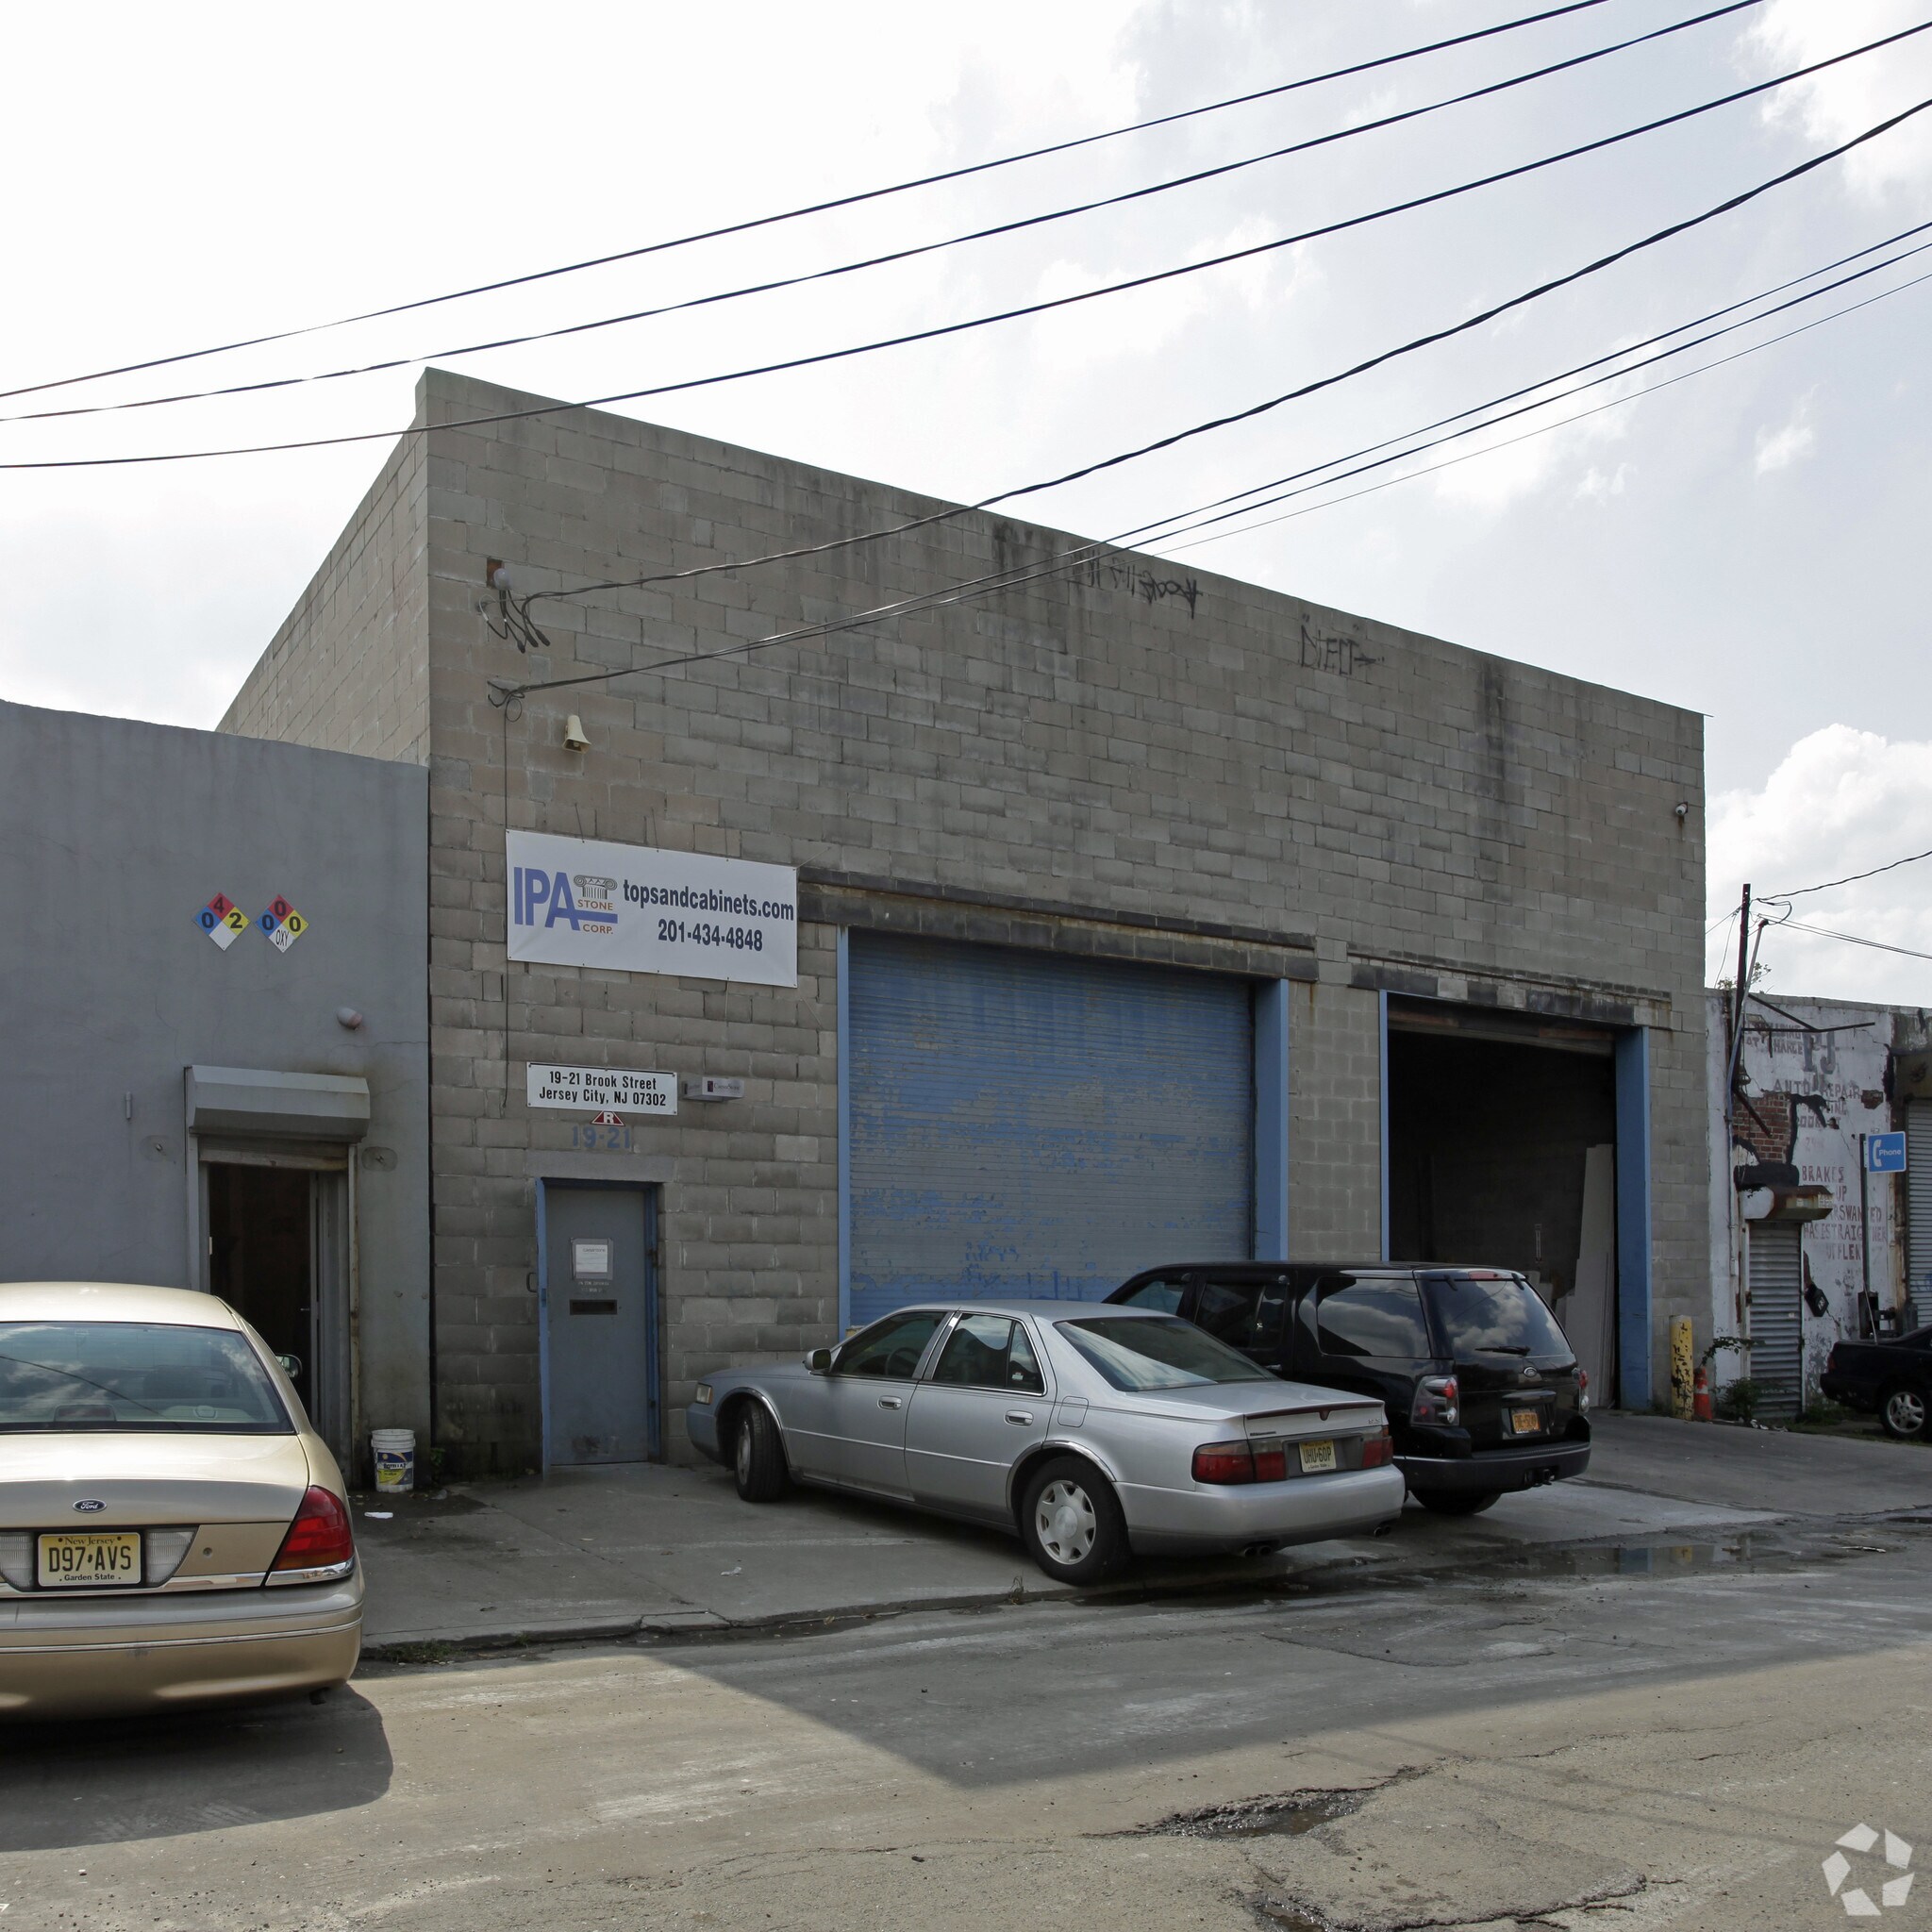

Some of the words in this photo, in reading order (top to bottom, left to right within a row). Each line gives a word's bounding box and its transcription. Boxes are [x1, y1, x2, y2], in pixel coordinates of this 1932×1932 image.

[213, 896, 225, 913] 4
[513, 866, 602, 932] IPA
[577, 898, 613, 911] STONE
[623, 878, 794, 921] topsandcabinets.com
[274, 900, 287, 916] 0
[201, 911, 214, 929] 0
[228, 912, 243, 929] 2
[261, 914, 275, 931] 0
[289, 916, 301, 932] 0
[275, 928, 290, 947] OXY
[582, 923, 614, 935] CORP.
[658, 918, 763, 952] 201-434-4848
[549, 1071, 580, 1085] 19-21
[585, 1073, 617, 1088] Brook
[622, 1076, 657, 1090] Street
[539, 1087, 577, 1102] Jersey
[583, 1089, 609, 1105] City,
[614, 1091, 627, 1104] NJ
[633, 1093, 666, 1106] 07302
[80, 1501, 99, 1509] Ford
[64, 1537, 85, 1545] New
[87, 1536, 115, 1546] Jersey
